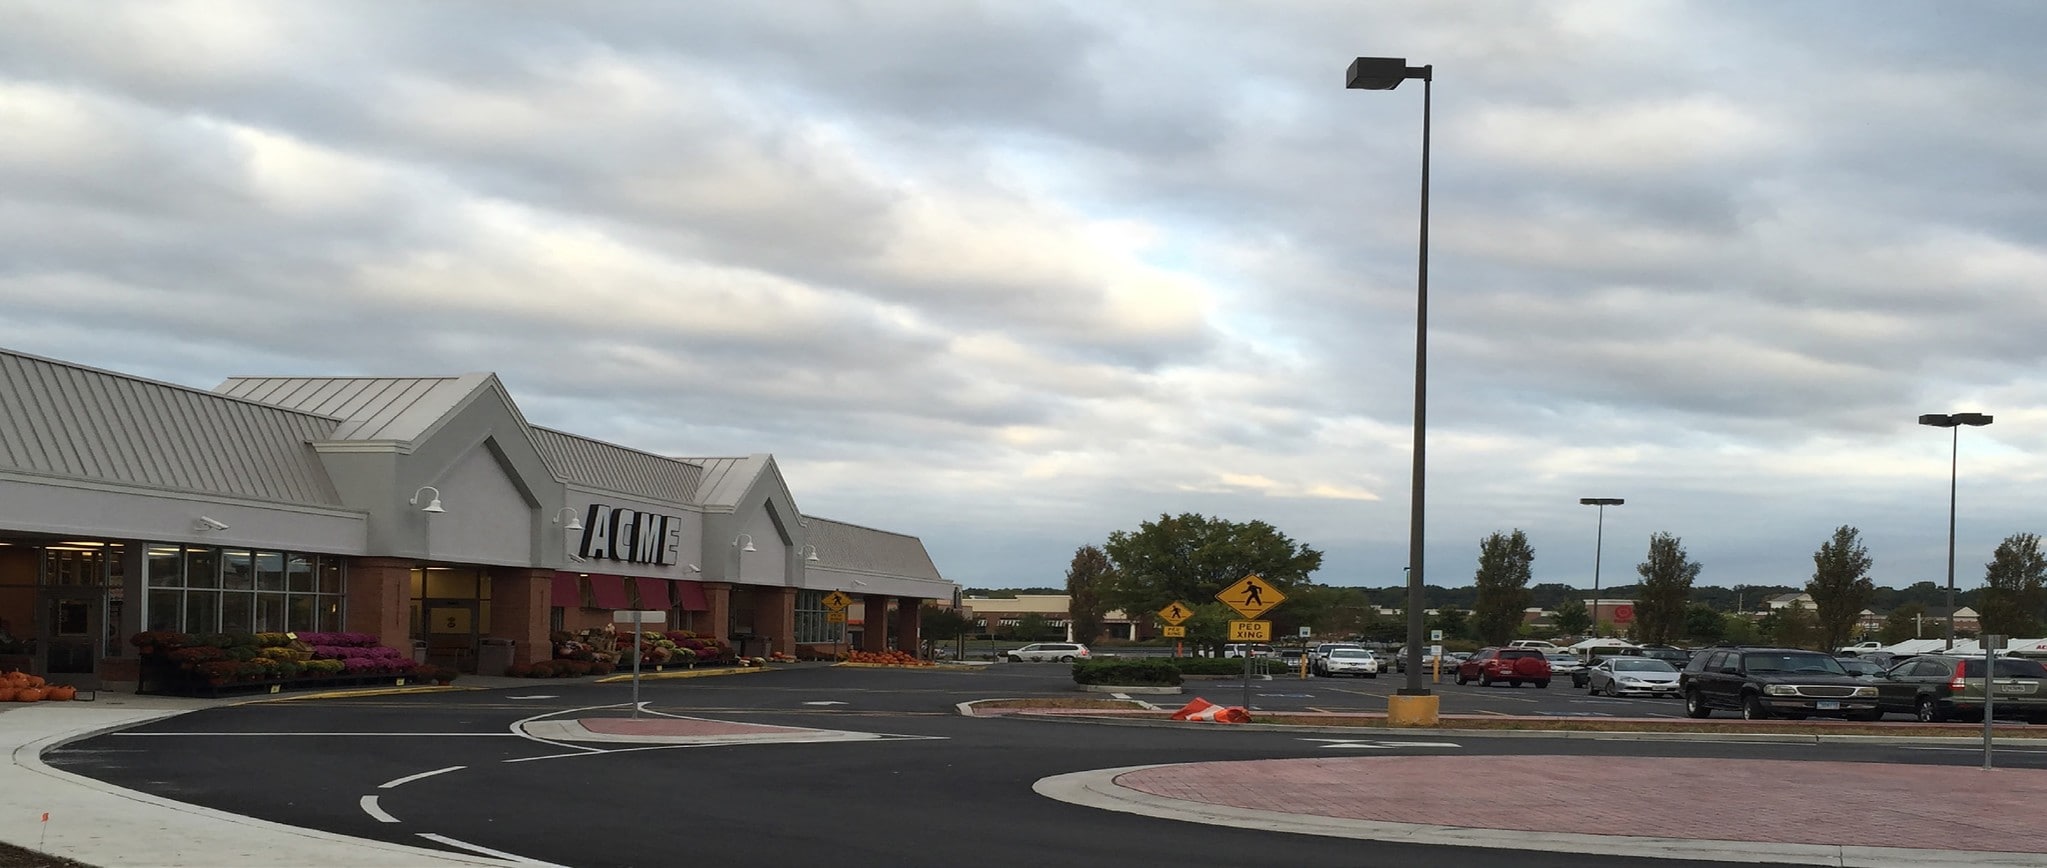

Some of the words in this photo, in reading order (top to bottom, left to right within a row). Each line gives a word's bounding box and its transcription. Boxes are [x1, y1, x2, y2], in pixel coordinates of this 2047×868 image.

[580, 504, 682, 566] ACME
[1238, 623, 1262, 631] PED
[1237, 631, 1263, 639] XING
